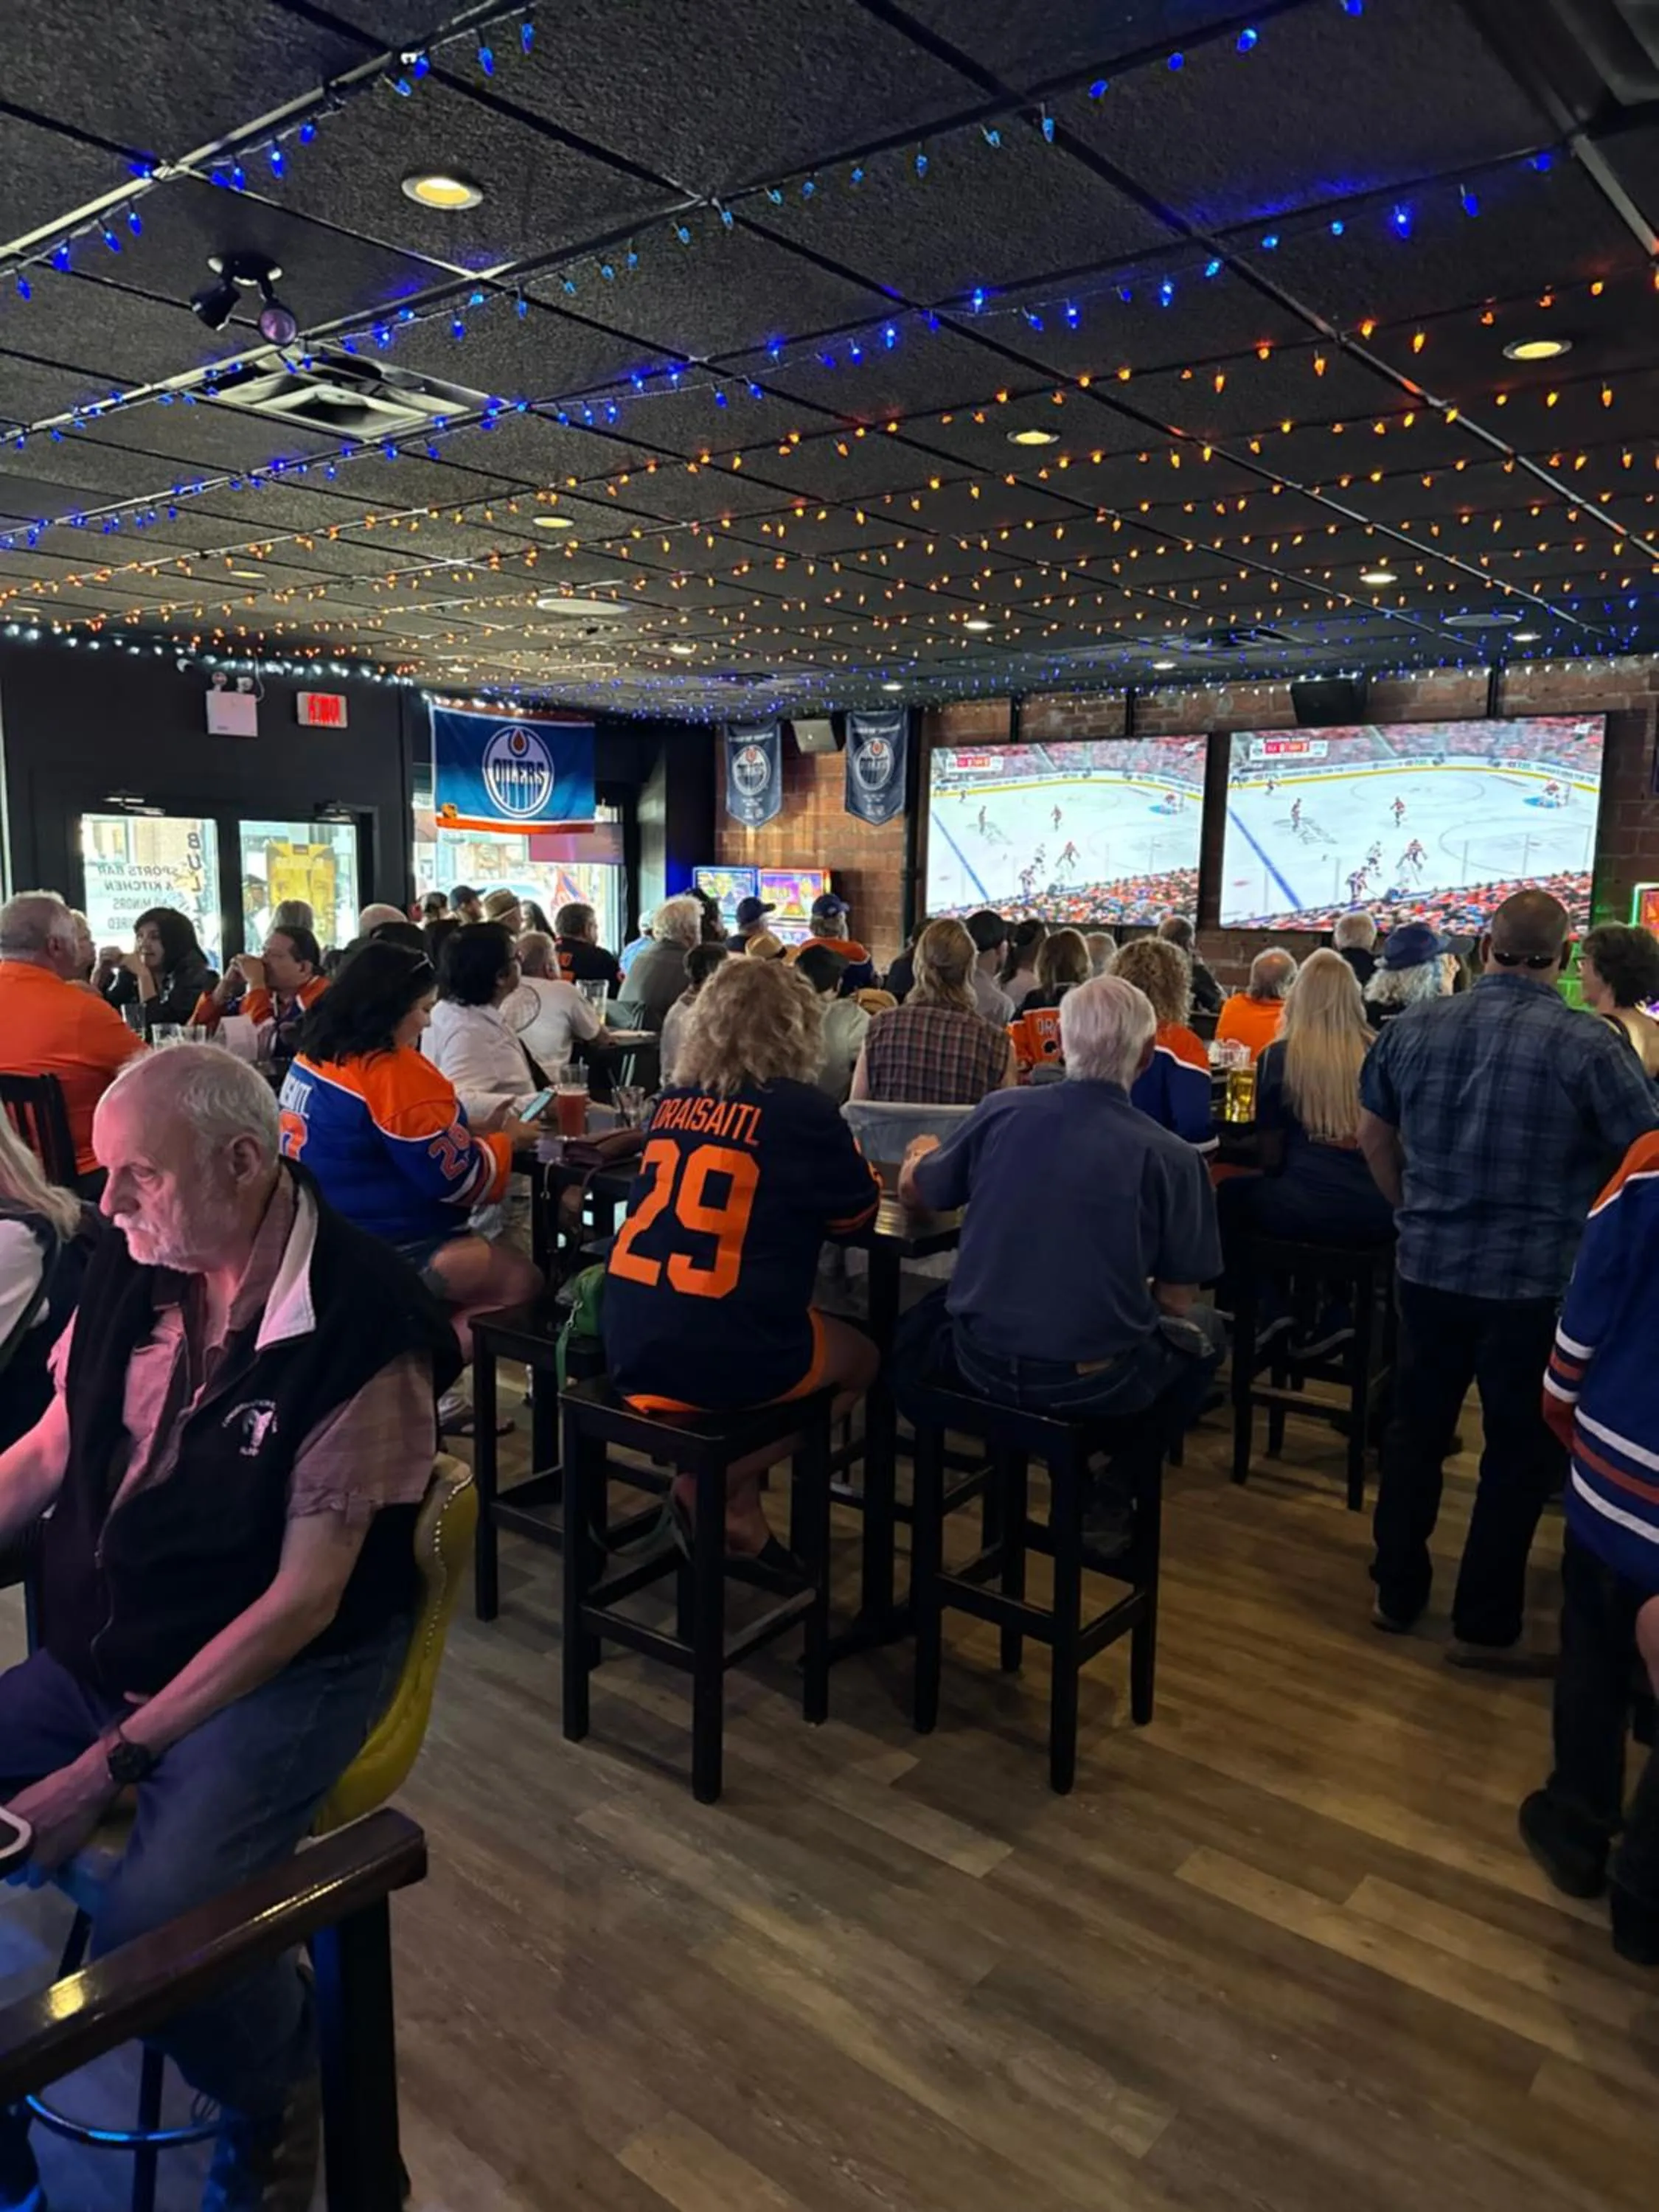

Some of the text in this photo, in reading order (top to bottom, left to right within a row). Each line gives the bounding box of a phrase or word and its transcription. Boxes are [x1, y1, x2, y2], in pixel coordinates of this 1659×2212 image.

[493, 758, 546, 785] OILERS
[650, 1096, 762, 1147] DRAISAITL
[608, 1138, 761, 1299] 29
